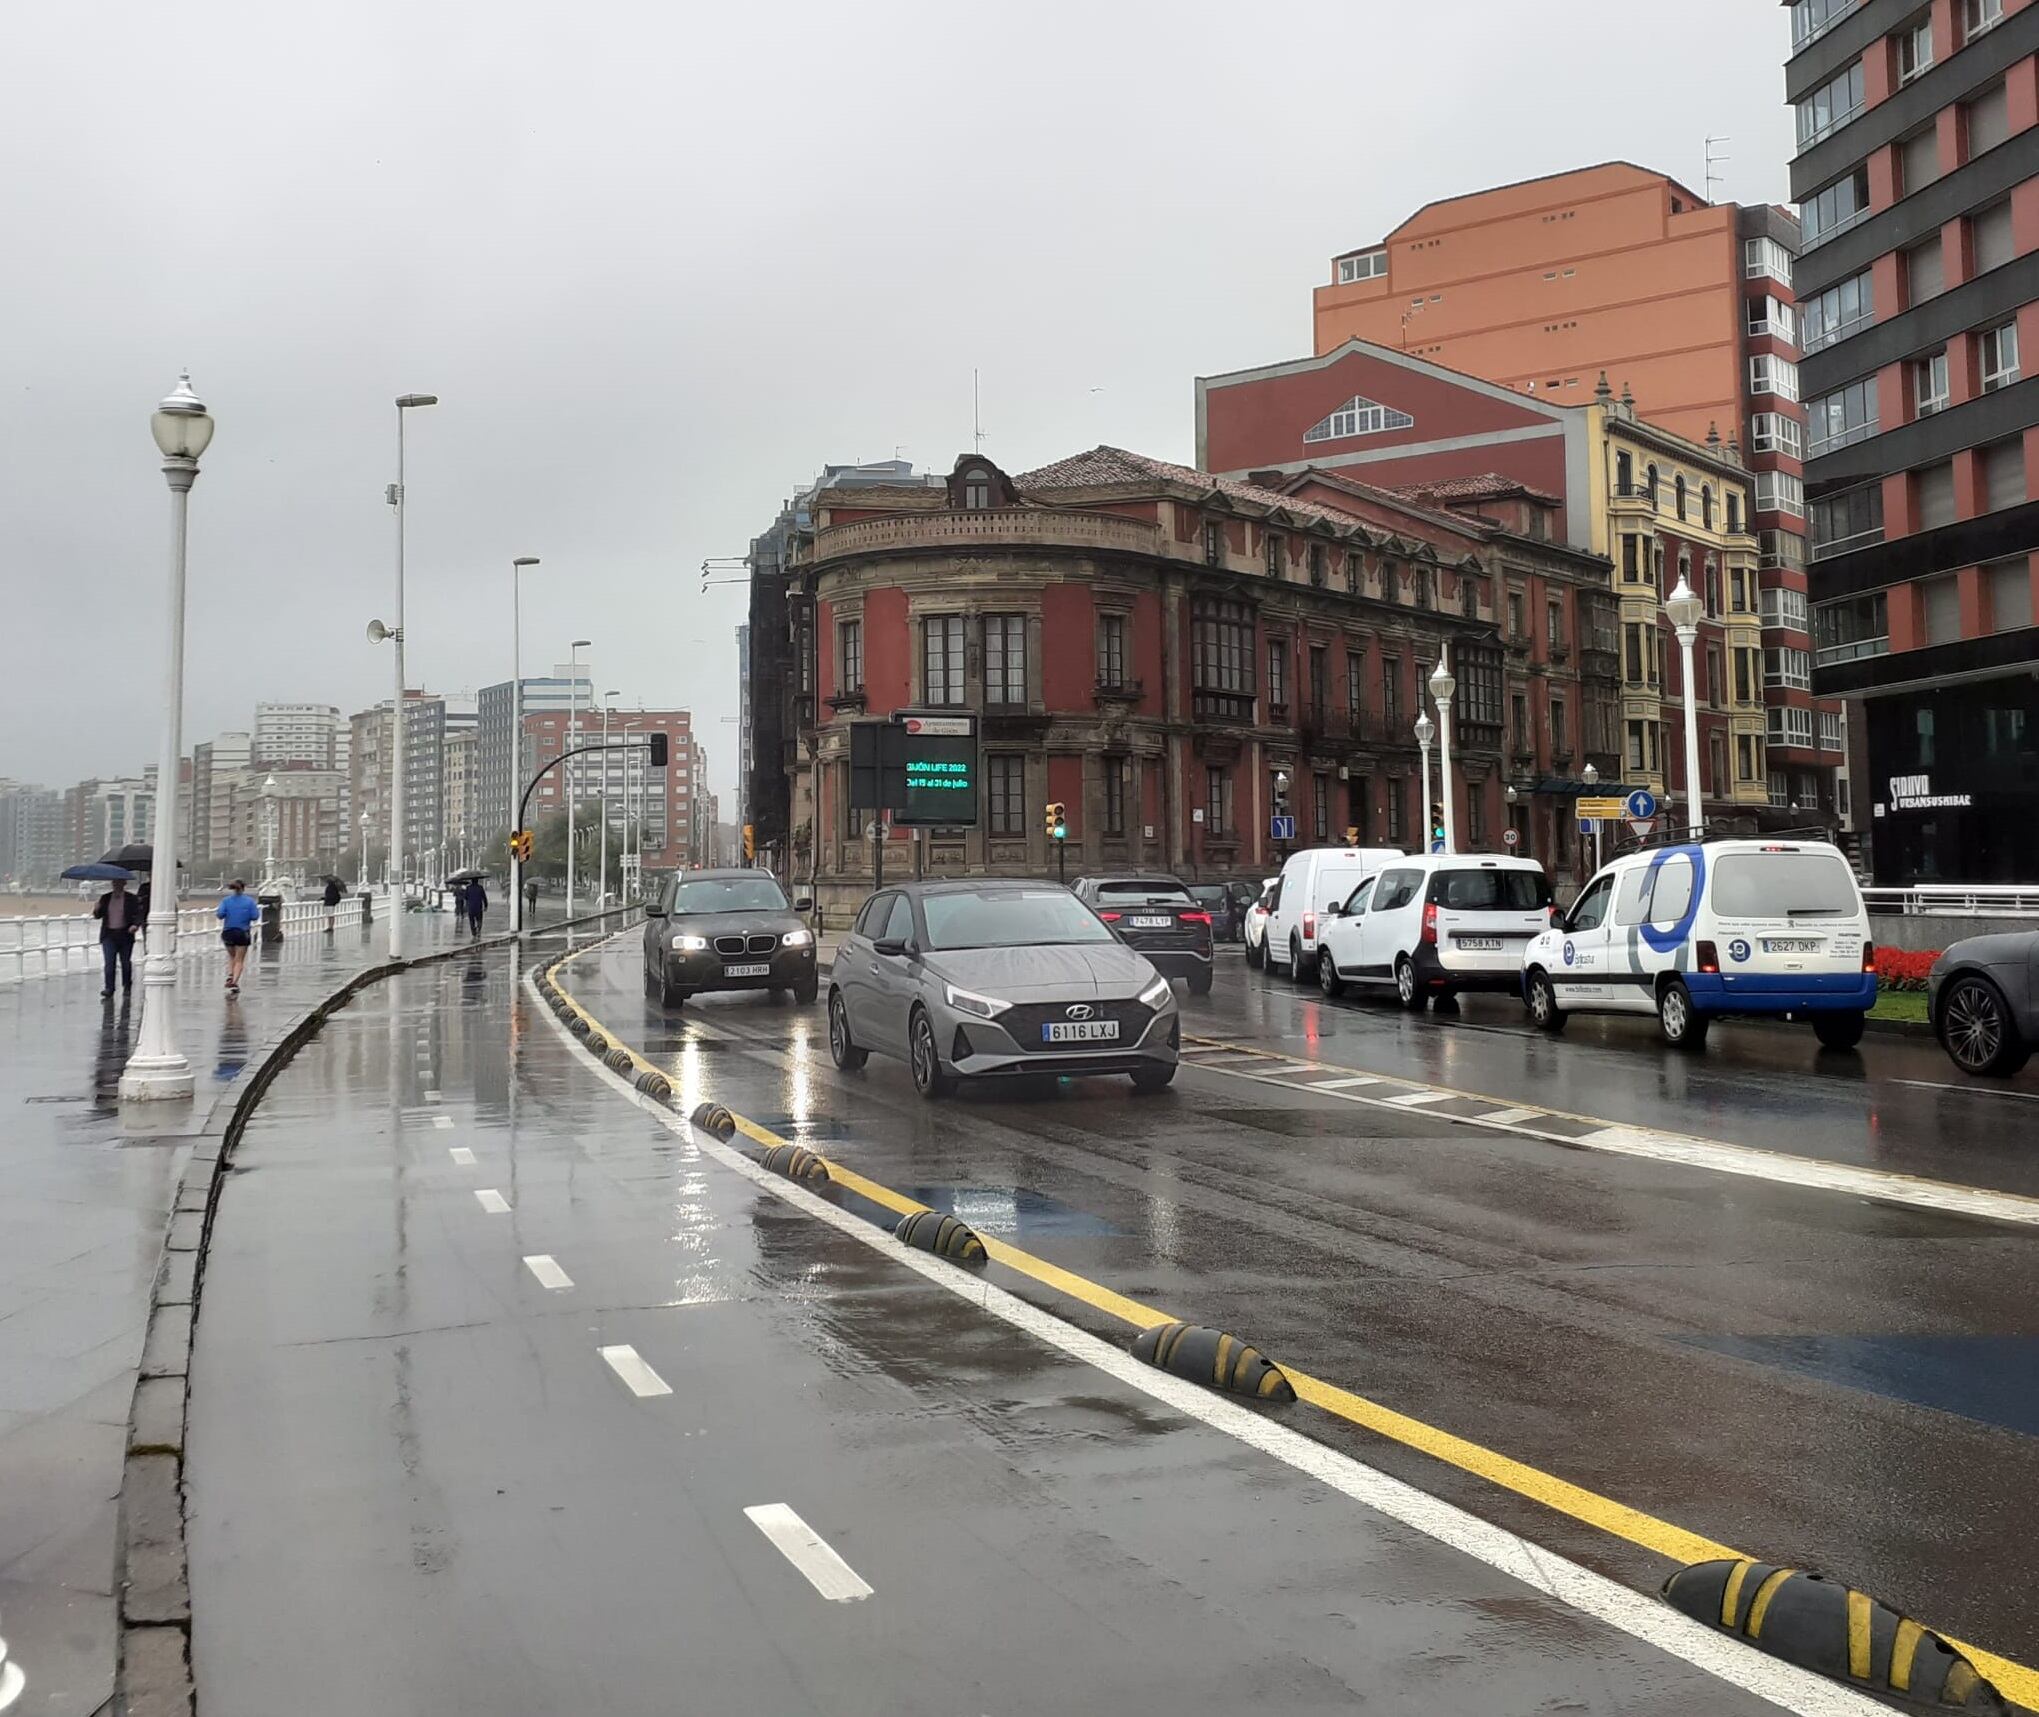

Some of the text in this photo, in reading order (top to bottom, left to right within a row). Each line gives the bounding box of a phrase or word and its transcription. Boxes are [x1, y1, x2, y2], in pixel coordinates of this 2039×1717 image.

[907, 761, 967, 772] GIJÓN LIFE 2022
[927, 779, 934, 787] al
[934, 779, 943, 787] 31
[943, 779, 952, 788] de
[952, 779, 968, 789] julio
[1505, 833, 1516, 841] 30
[1771, 940, 1817, 953] 2627 DKP
[730, 965, 768, 975] 2103 HRH
[1053, 1023, 1116, 1039] 6116 LXJ
